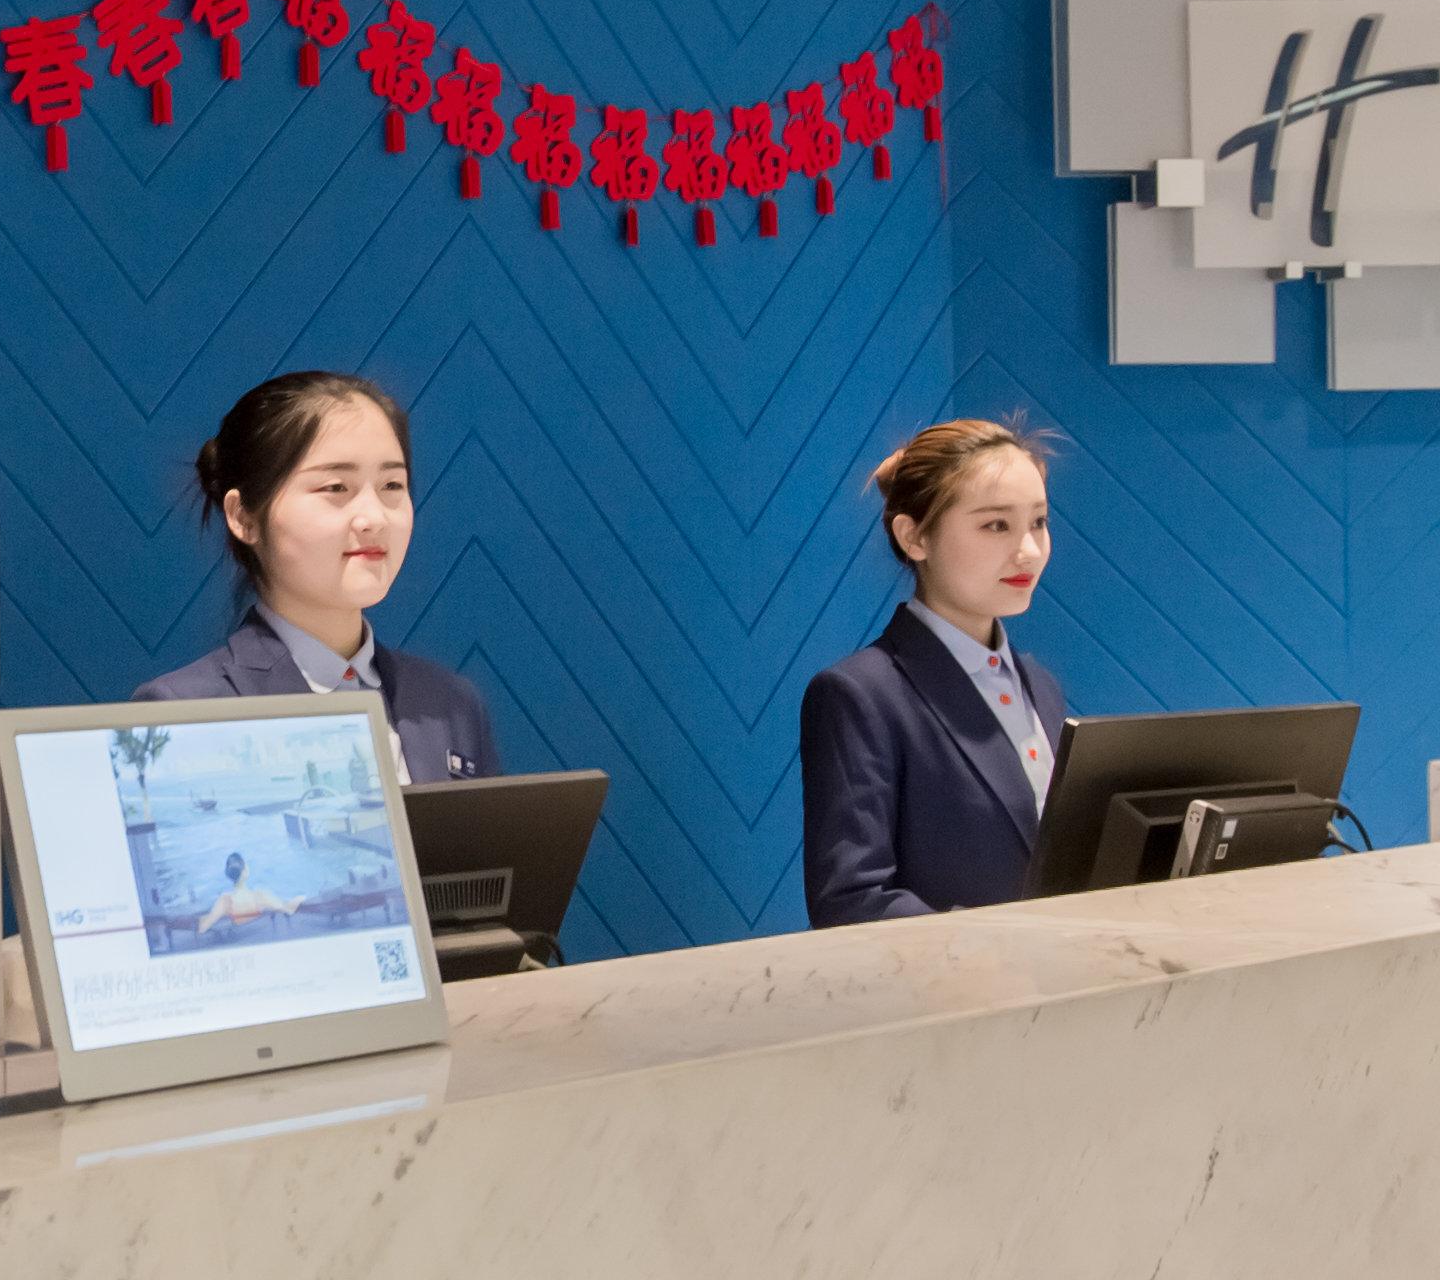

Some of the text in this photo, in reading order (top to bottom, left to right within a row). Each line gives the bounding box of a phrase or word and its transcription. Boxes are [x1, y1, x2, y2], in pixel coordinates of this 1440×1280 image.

[0, 15, 93, 125] 春
[359, 1, 436, 113] 福
[431, 48, 505, 156] 福
[511, 84, 582, 187] 福
[591, 106, 660, 201] 福
[662, 108, 729, 202] 福
[725, 101, 790, 198] 福
[782, 82, 842, 177] 福
[839, 50, 895, 146] 福
[887, 14, 944, 109] 福
[54, 907, 85, 927] IHG
